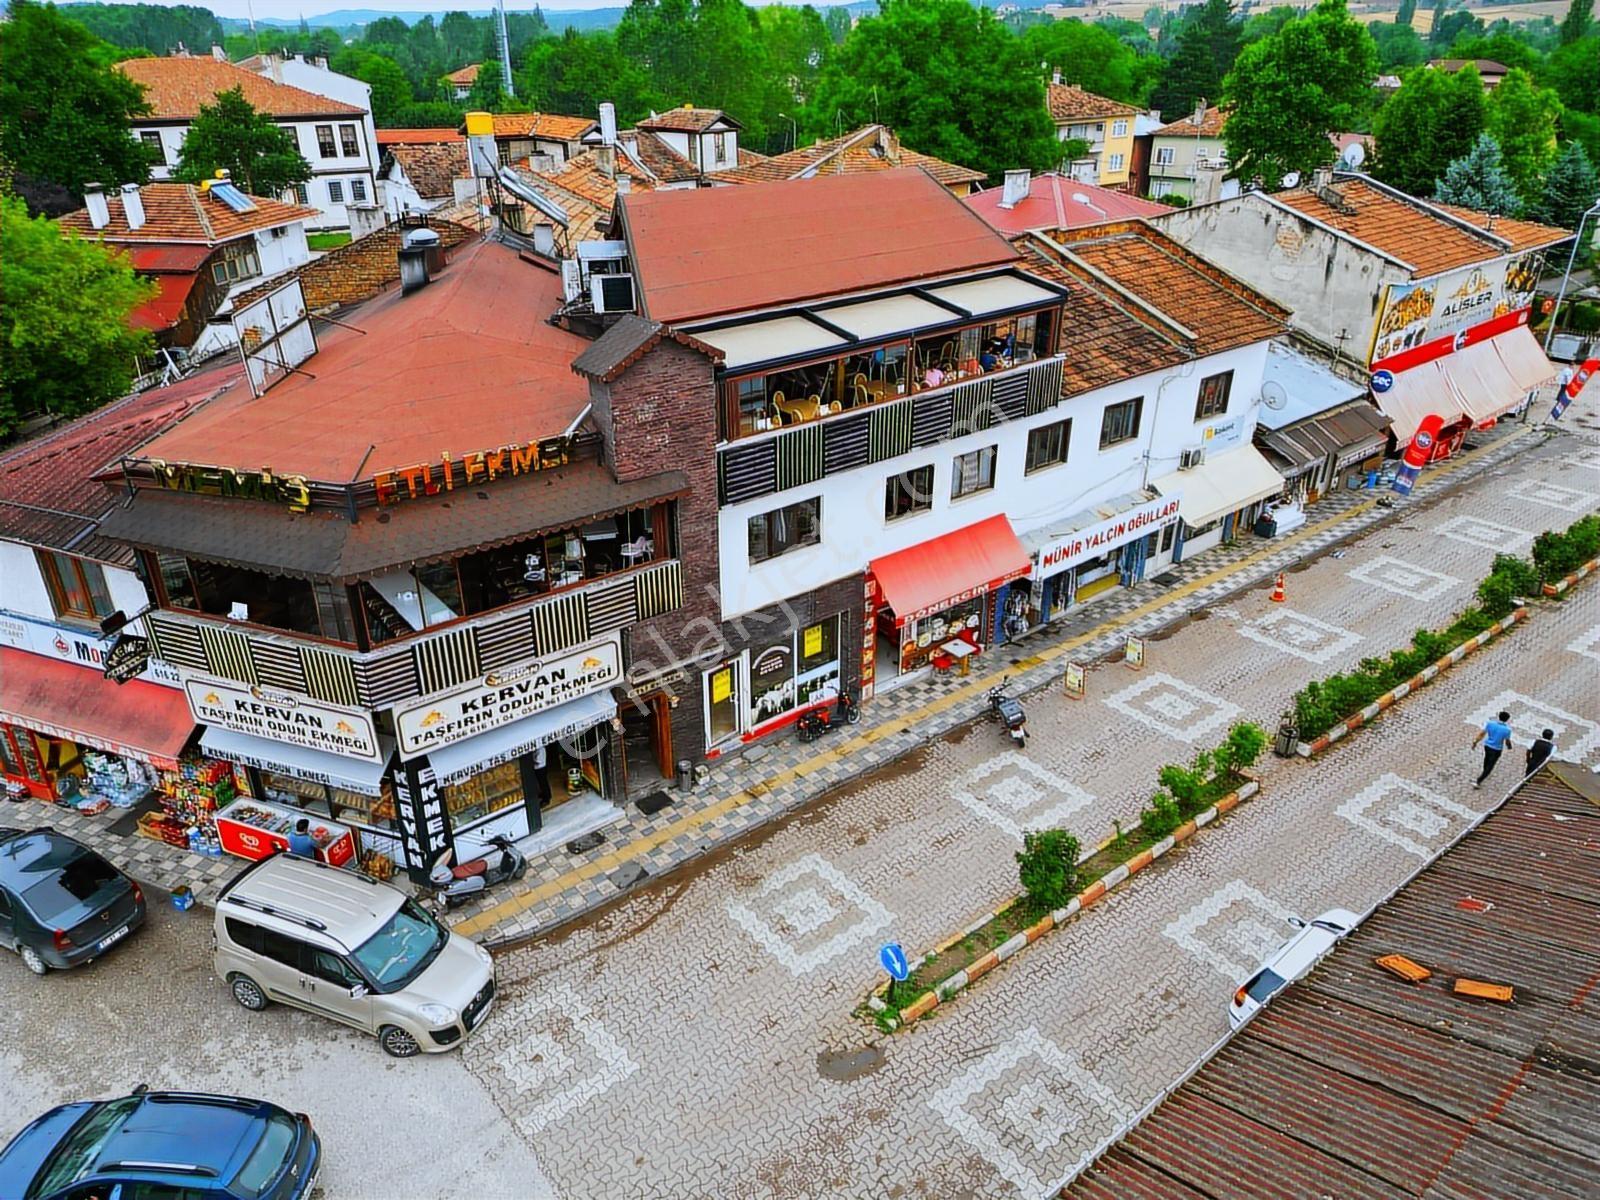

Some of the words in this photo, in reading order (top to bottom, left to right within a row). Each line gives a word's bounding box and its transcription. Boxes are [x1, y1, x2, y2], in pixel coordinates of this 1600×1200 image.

[1043, 540, 1082, 569] MÜNİR
[1085, 522, 1126, 550] YALÇIN
[1128, 499, 1180, 533] OĞULLARI
[234, 699, 323, 729] KERVAN
[410, 708, 493, 745] TAŞFIRIN
[499, 691, 544, 714] ODUN
[551, 666, 612, 695] EKMEĞİ
[461, 668, 567, 714] KERVAN
[199, 706, 264, 728] TAŞFIRIN
[268, 720, 306, 738] ODUN
[311, 730, 368, 751] EKMEĞİ
[207, 748, 241, 763] KERVAN
[267, 761, 291, 775] ODUN
[443, 762, 483, 785] KERVAN
[511, 738, 537, 758] ODUN
[394, 769, 423, 869] KERVAN
[418, 767, 446, 852] EKMEK
